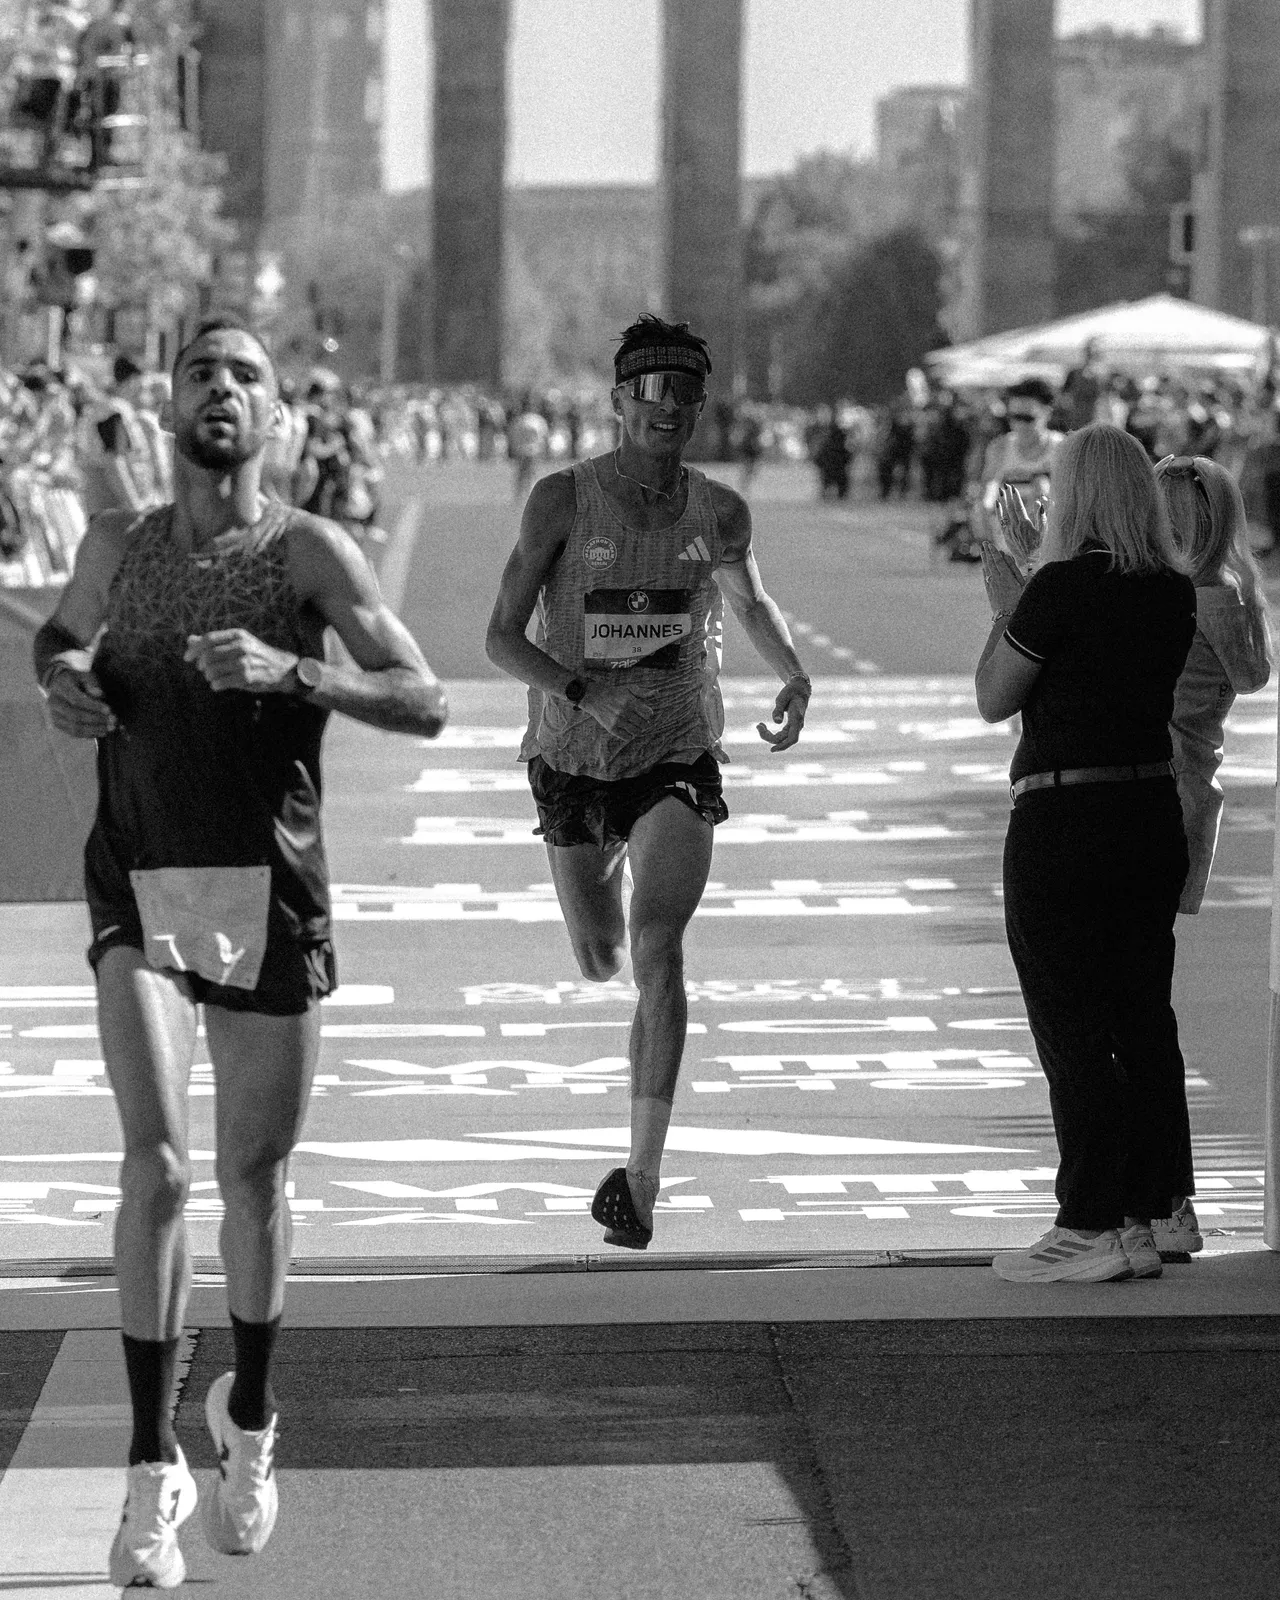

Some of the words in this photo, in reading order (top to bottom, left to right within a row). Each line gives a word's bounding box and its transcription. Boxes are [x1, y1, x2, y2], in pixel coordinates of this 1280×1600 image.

[585, 539, 608, 558] MARATHON
[591, 624, 683, 639] JOHANNES
[632, 646, 642, 654] 38
